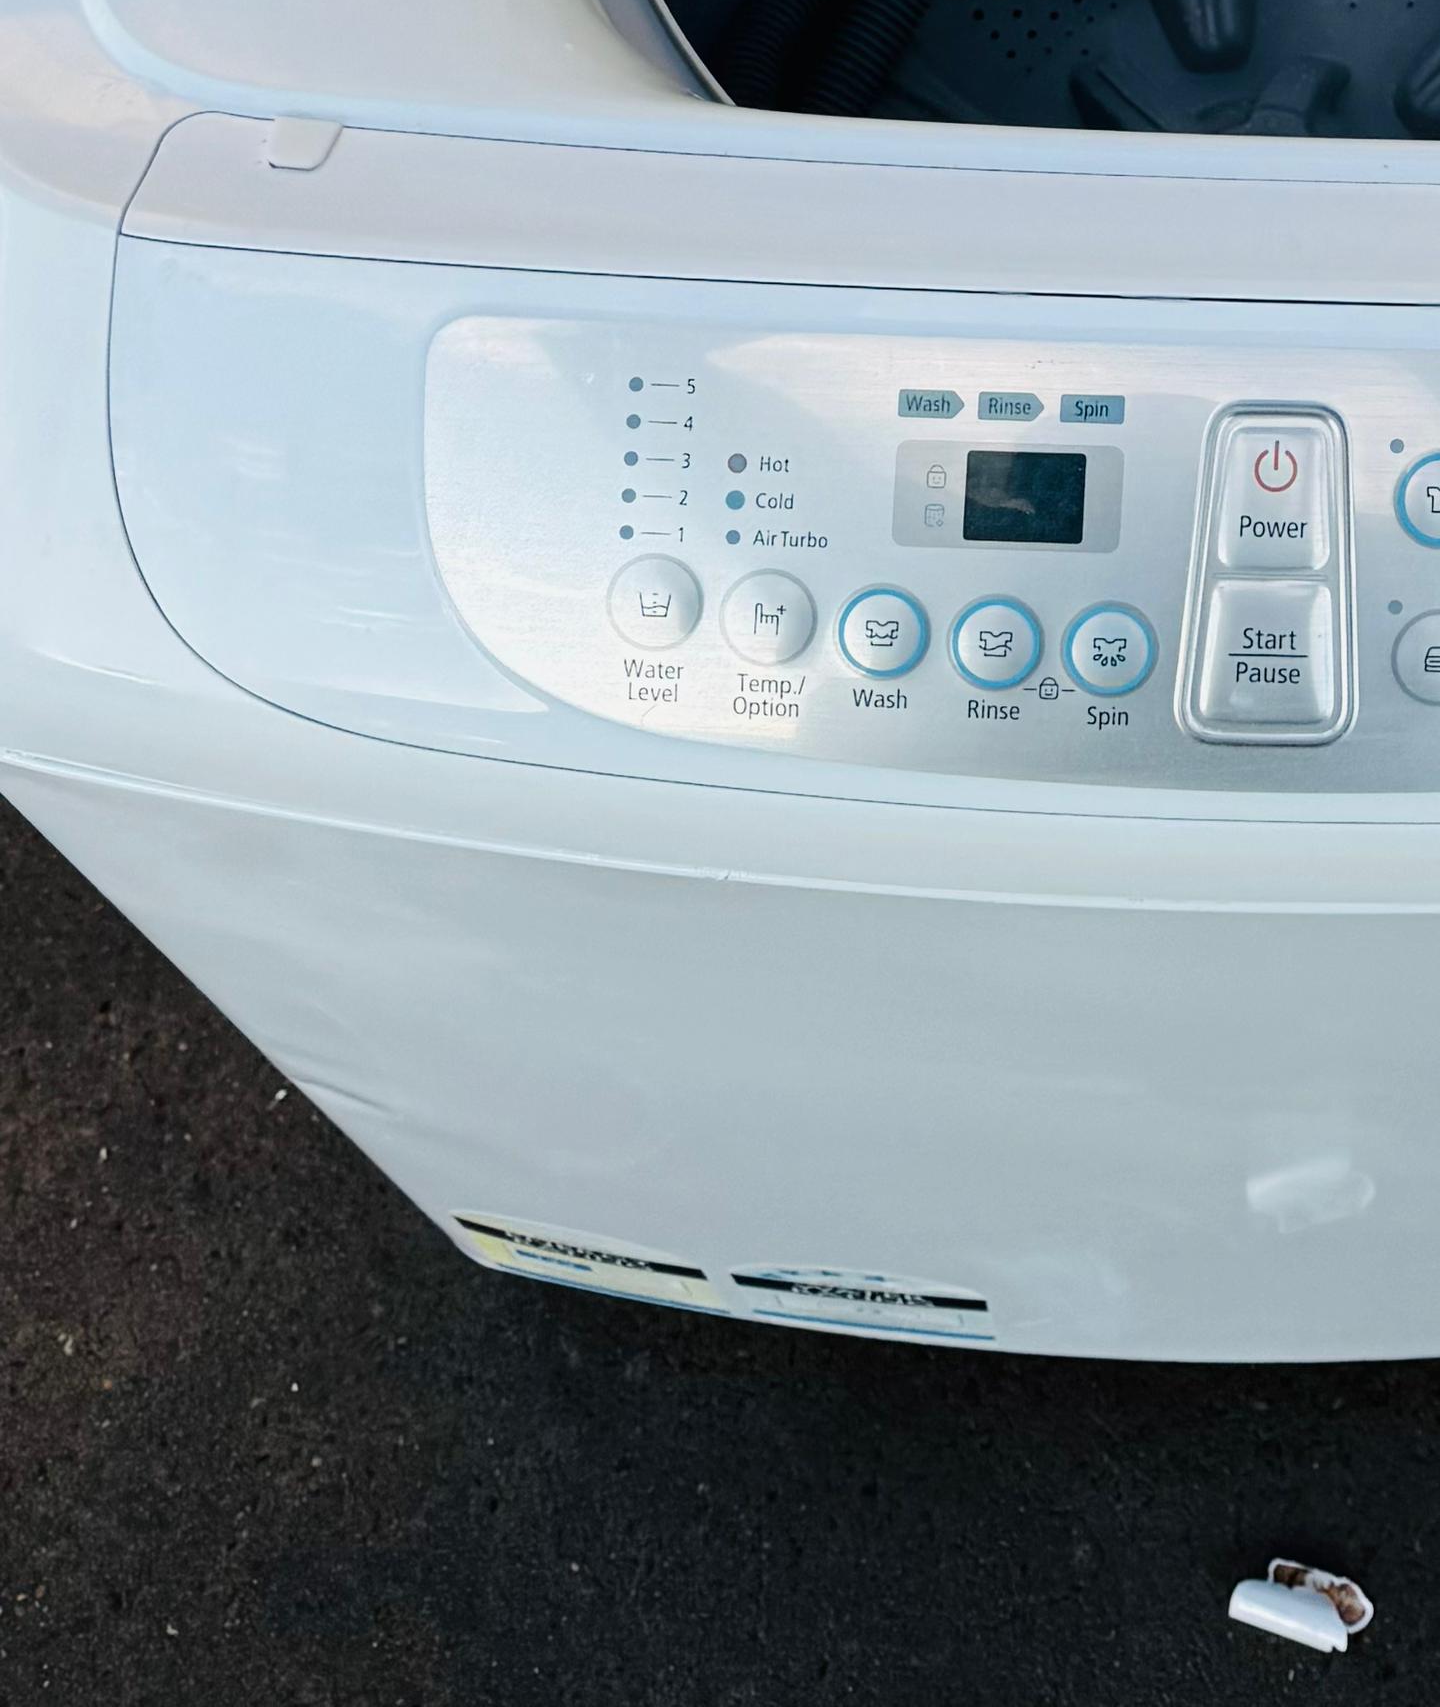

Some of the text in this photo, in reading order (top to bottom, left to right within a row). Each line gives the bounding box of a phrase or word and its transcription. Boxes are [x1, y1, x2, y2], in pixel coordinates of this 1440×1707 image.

[686, 378, 696, 394] 5
[906, 395, 950, 414] Wash
[988, 397, 1032, 417] Rinse
[1074, 399, 1109, 421] Spin
[683, 416, 694, 432] 4
[681, 453, 691, 469] 3
[759, 454, 789, 473] Hot
[678, 490, 689, 506] 2
[755, 491, 795, 511] Cold
[677, 527, 684, 543] 1
[1239, 515, 1308, 539] Power
[781, 530, 828, 549] Turbo
[1242, 627, 1297, 651] Start
[623, 658, 684, 680] Water
[1235, 661, 1301, 685] Pause
[627, 681, 679, 704] Level
[737, 673, 806, 698] Temp./
[732, 696, 800, 719] Option
[852, 688, 908, 711] Wash
[967, 699, 1020, 721] Rinse
[1086, 706, 1130, 730] Spin
